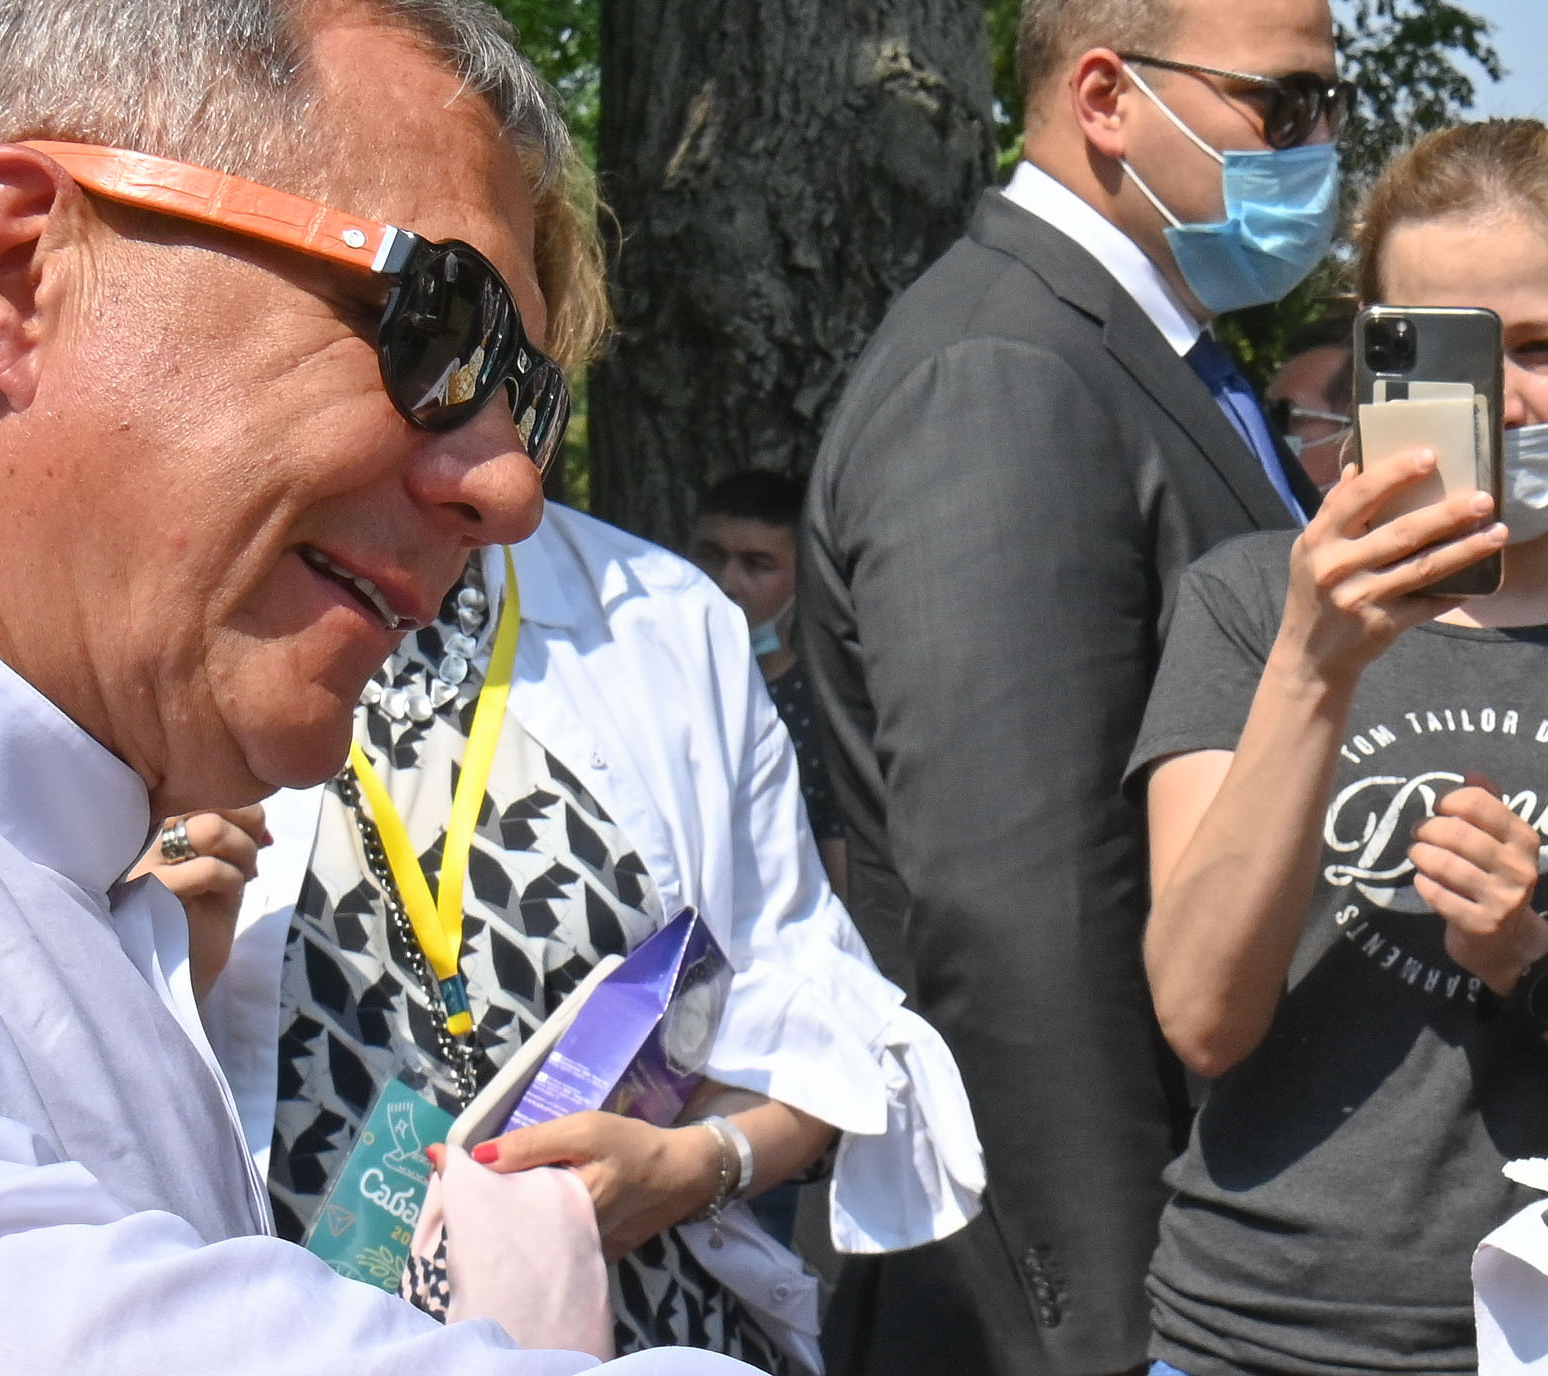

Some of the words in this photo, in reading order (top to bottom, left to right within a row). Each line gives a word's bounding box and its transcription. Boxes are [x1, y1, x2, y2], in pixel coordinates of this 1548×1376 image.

[1340, 724, 1397, 763] TOM
[1404, 707, 1519, 735] TAILOR
[1334, 904, 1483, 1003] GARMENTS
[360, 1167, 422, 1225] Саба
[390, 1225, 412, 1246] 20
